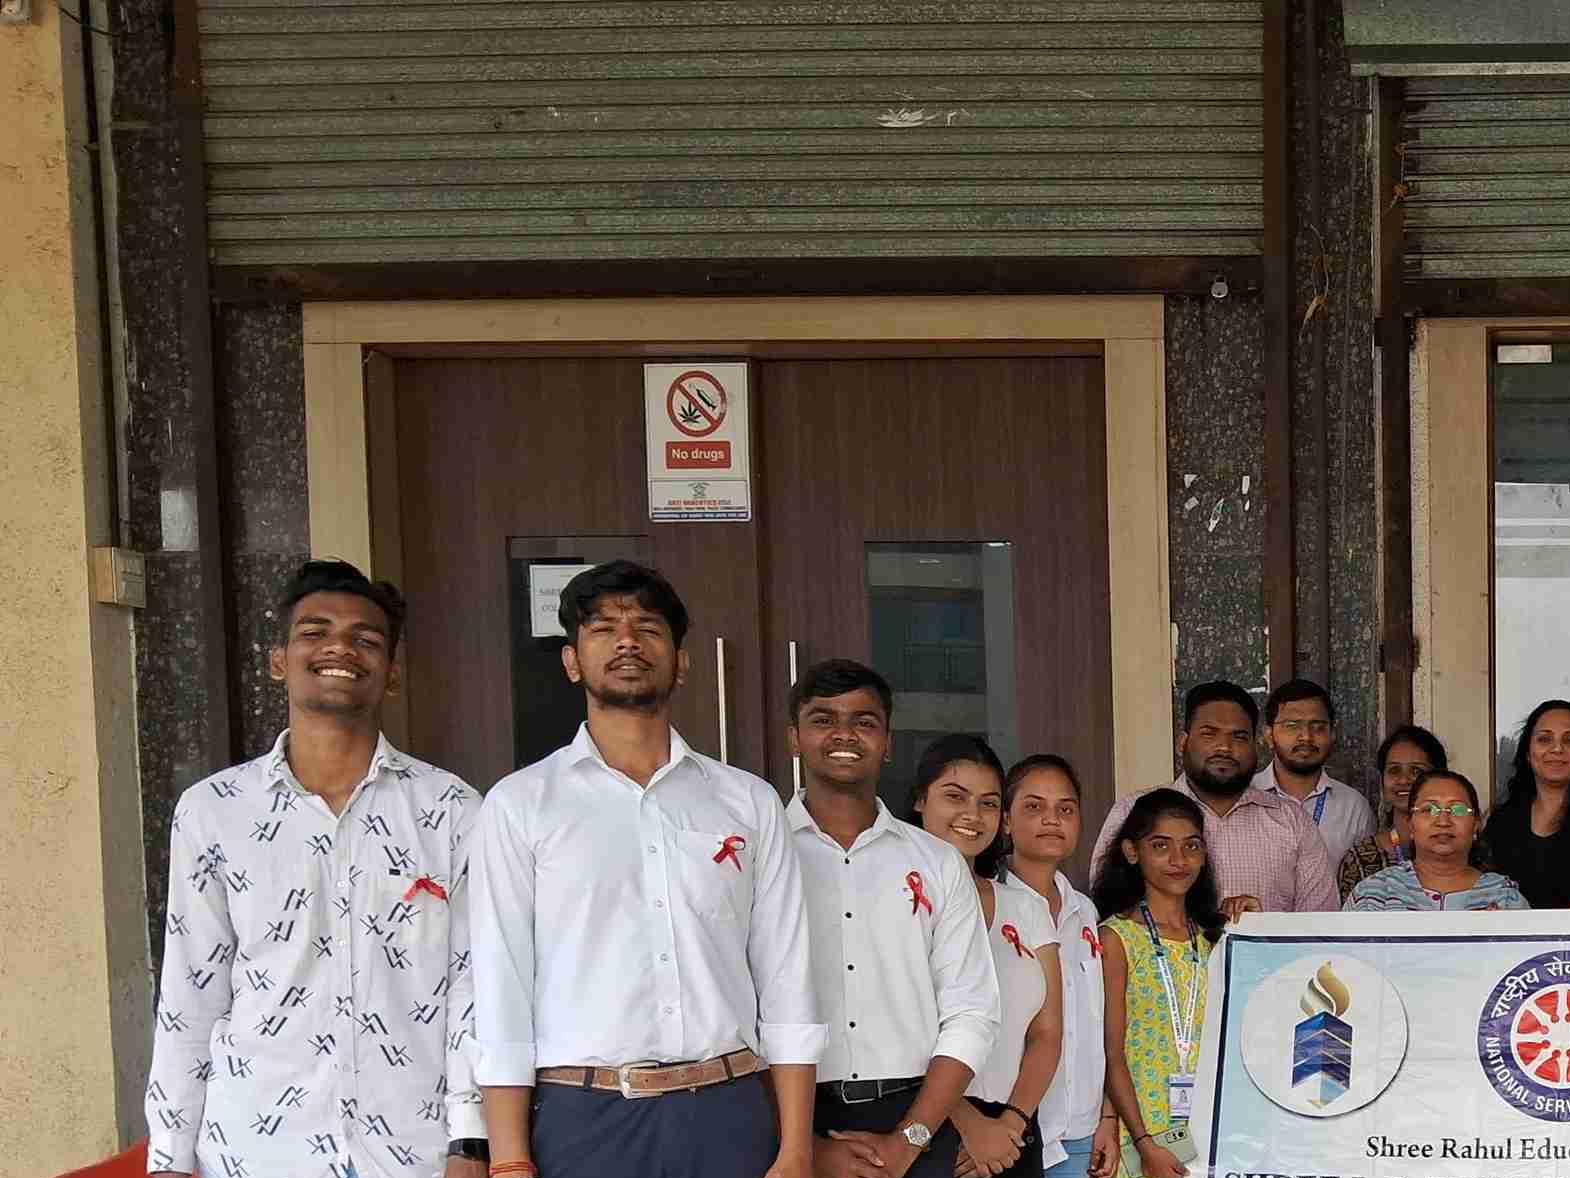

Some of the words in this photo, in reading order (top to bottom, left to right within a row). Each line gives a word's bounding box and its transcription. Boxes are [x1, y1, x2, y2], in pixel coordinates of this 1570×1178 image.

[671, 448, 689, 460] No
[691, 447, 725, 462] drugs
[1486, 1036, 1529, 1105] NATIONAL
[1365, 1136, 1434, 1159] Shree
[1441, 1138, 1512, 1160] Rahul
